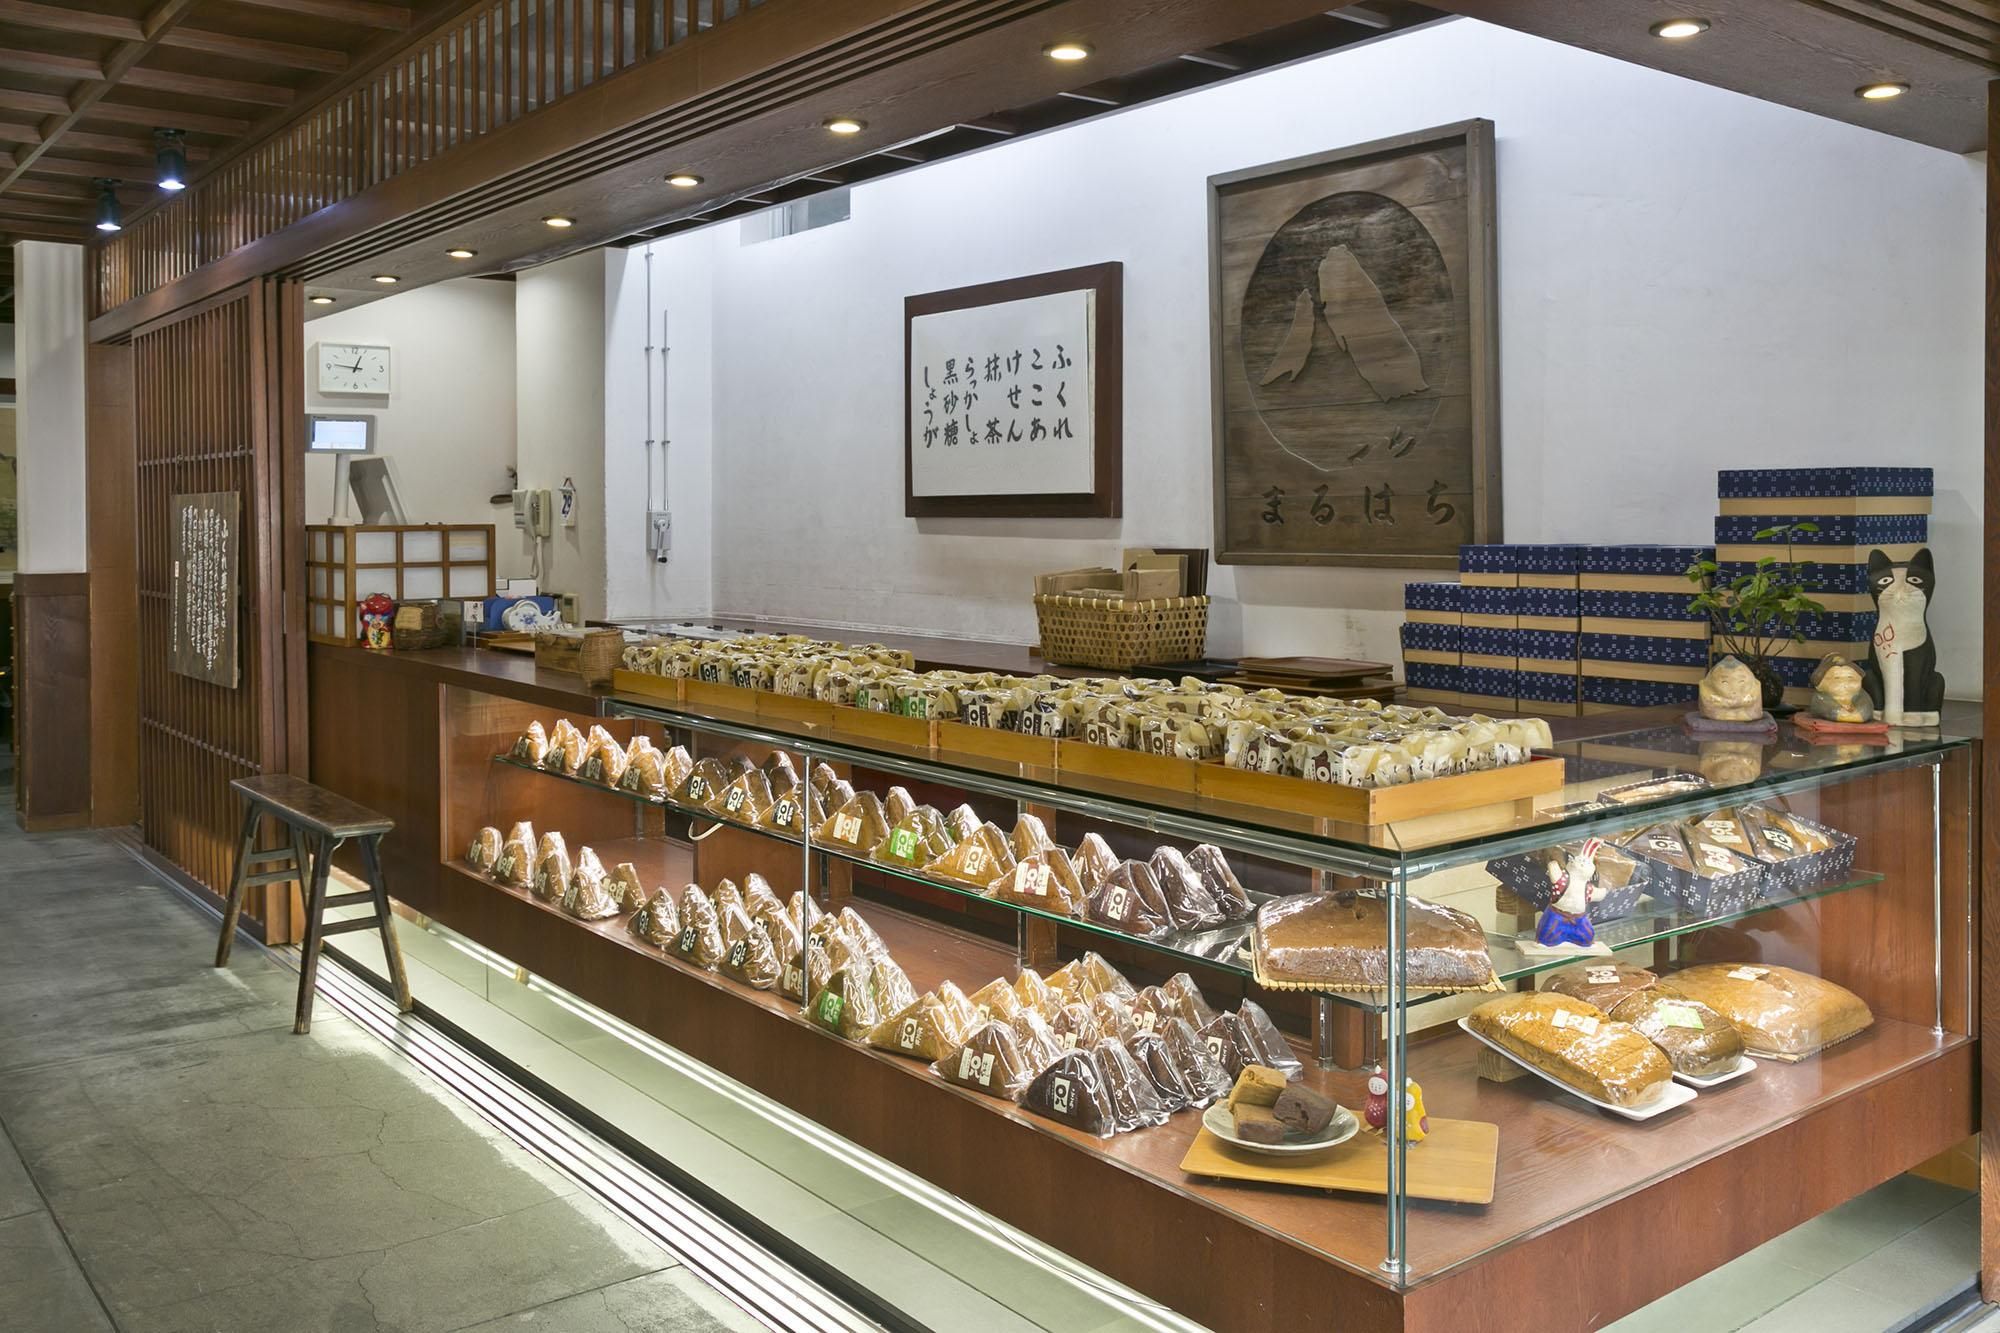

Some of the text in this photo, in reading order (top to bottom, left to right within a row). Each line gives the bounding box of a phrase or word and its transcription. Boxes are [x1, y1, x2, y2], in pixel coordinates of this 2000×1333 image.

[351, 347, 359, 355] 12
[353, 381, 358, 390] 6
[379, 365, 384, 373] 3
[1052, 344, 1073, 440] ふくれ
[923, 365, 939, 449] しょうが
[943, 358, 959, 447] 黒砂糖
[984, 353, 1002, 445] 抹茶
[1006, 350, 1023, 442] けせん
[1030, 348, 1047, 441] ここあ
[1262, 480, 1455, 525] まるはち
